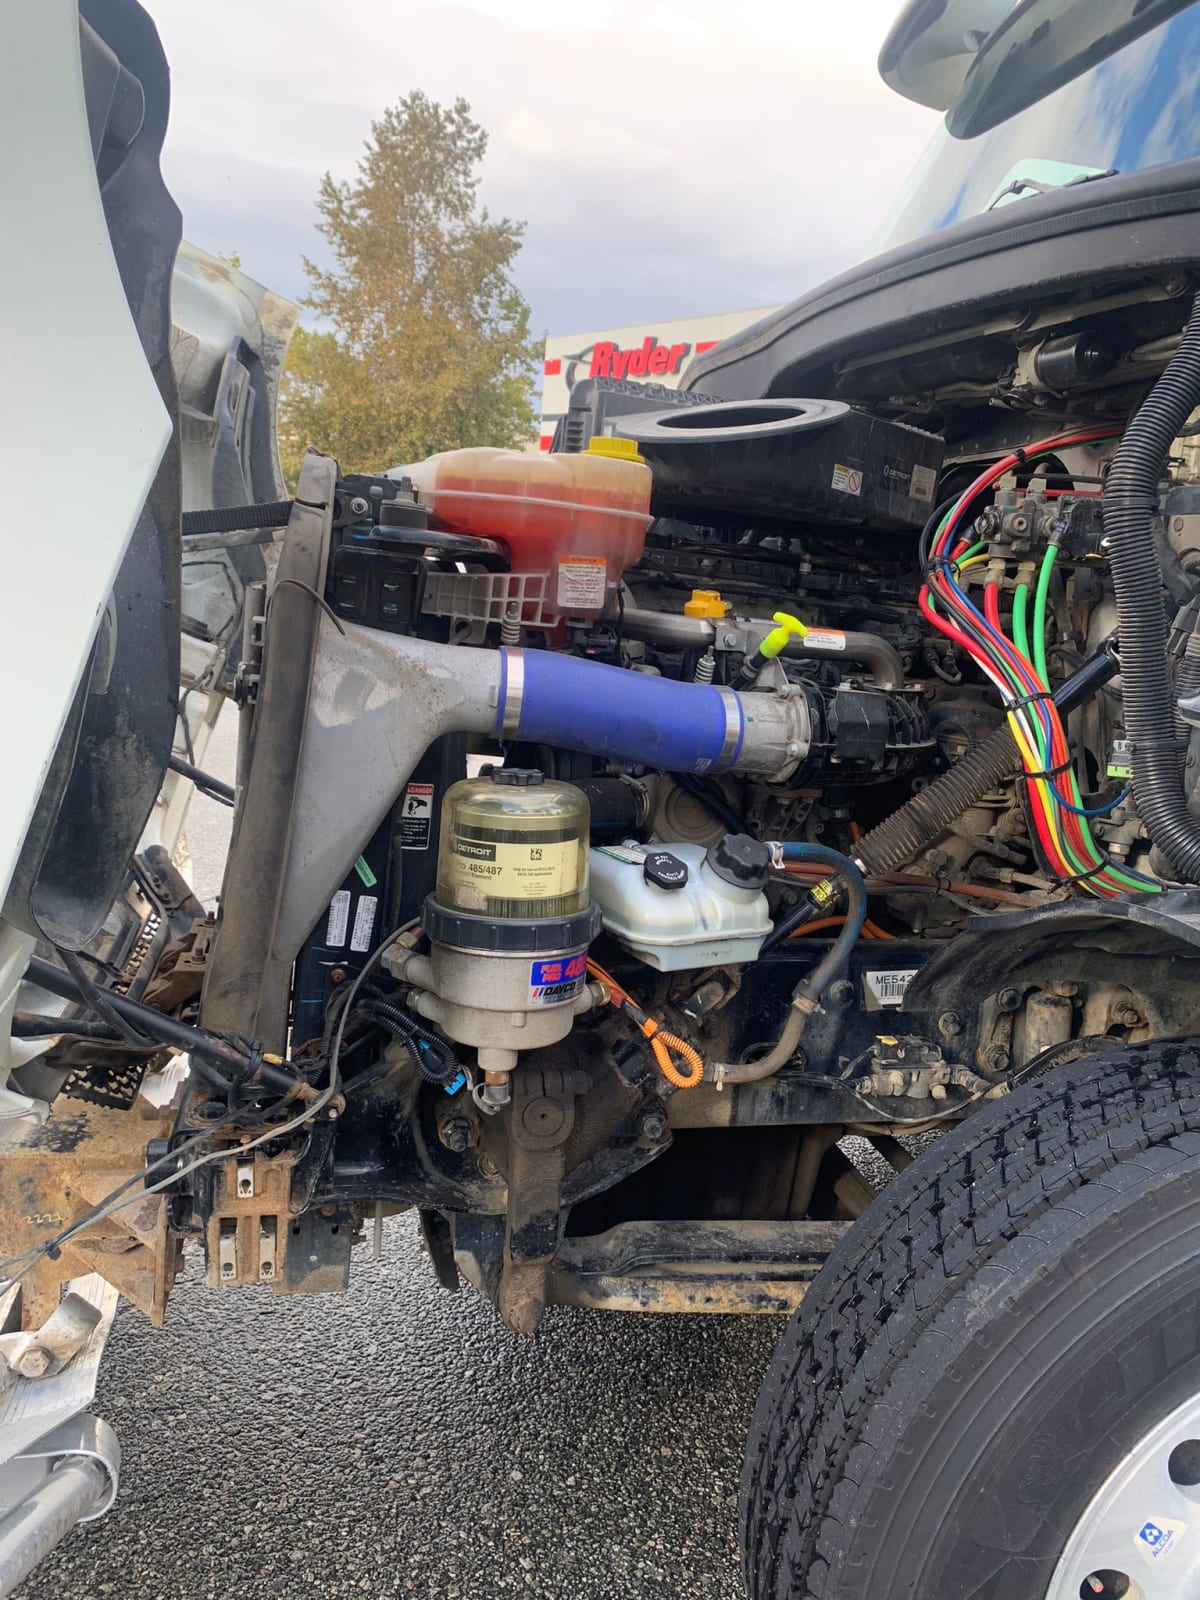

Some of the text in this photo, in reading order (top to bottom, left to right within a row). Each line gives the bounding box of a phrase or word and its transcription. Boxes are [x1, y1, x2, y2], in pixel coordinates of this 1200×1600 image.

[589, 336, 687, 380] Ryder
[457, 843, 492, 856] DETROIT
[468, 863, 503, 876] 485/487
[541, 963, 562, 974] FUEL
[542, 972, 562, 982] PRO
[543, 981, 577, 996] DAVCO
[1152, 1529, 1175, 1558] ALCOA
